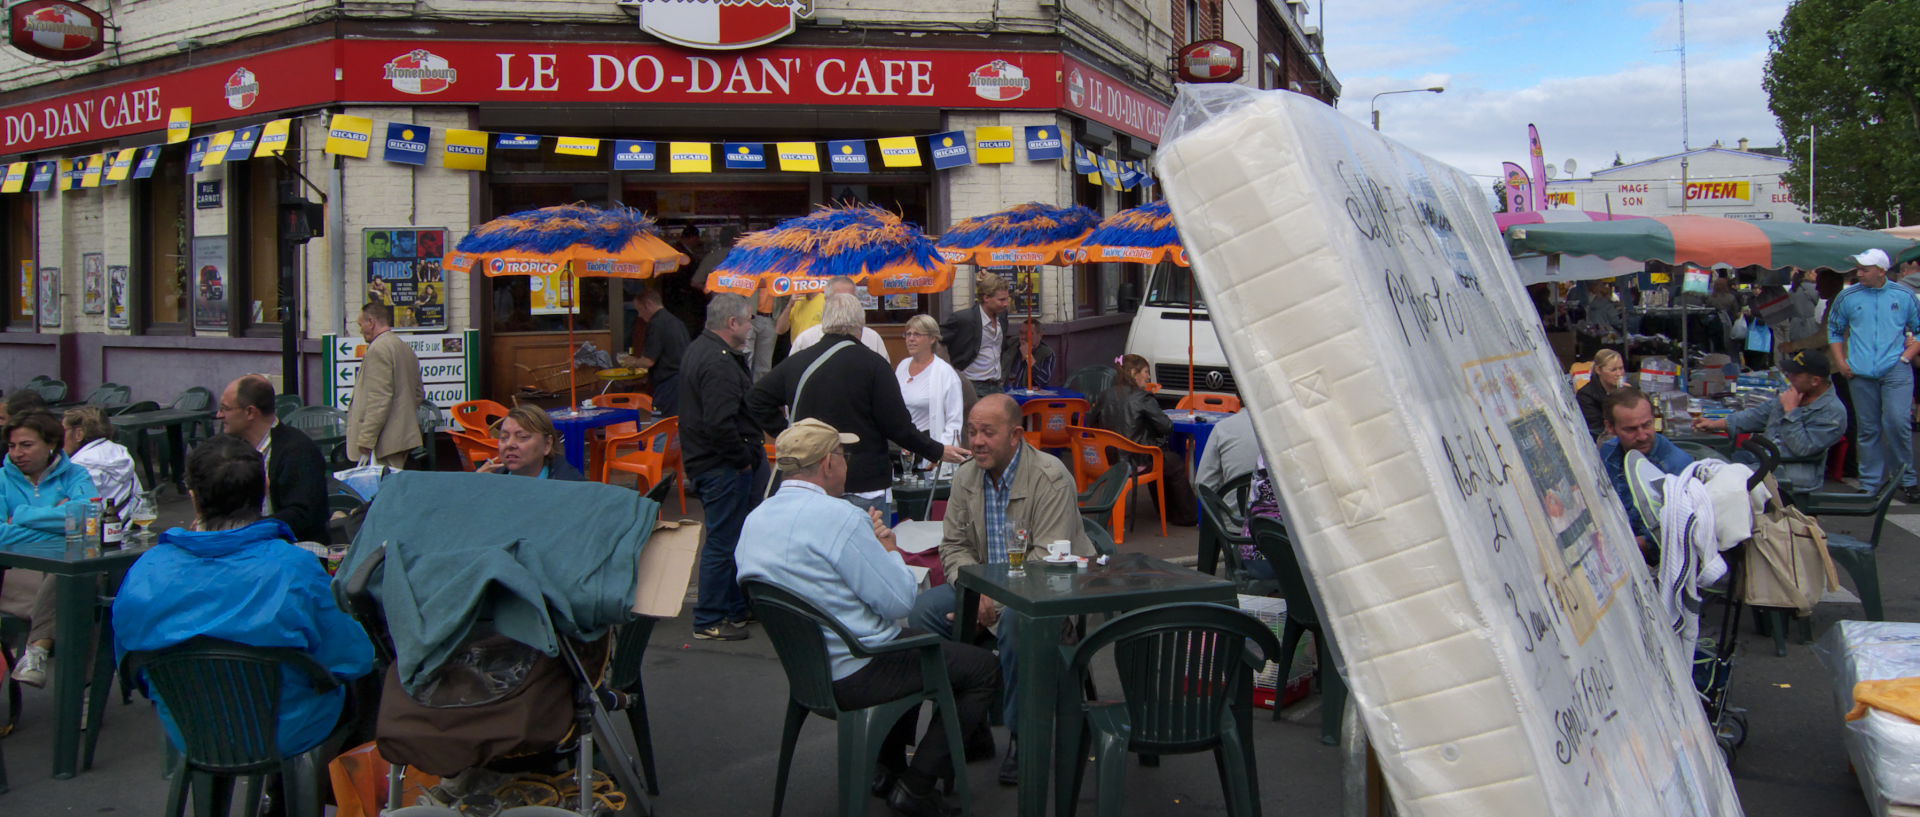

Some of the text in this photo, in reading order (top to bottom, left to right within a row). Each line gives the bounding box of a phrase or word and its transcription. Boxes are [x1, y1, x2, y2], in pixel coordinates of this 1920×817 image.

[384, 63, 456, 83] Kronenbourg
[496, 53, 935, 96] LE DO-DAN' CAFE
[968, 72, 1030, 92] Kronenbourg
[1089, 77, 1103, 113] LE
[5, 87, 161, 146] DO-DAN' CAFE
[331, 130, 368, 142] RICARD
[388, 140, 426, 153] RICARD
[447, 144, 485, 155] RICARD
[978, 140, 1011, 149] RICARD
[1028, 139, 1060, 149] RICARD
[934, 146, 966, 158] RICARD
[832, 154, 866, 163] RICARD
[203, 184, 214, 193] RUE
[1618, 183, 1649, 193] IMAGE
[1686, 183, 1737, 200] GITEM
[198, 194, 220, 203] CARNOT
[1622, 197, 1643, 206] SON
[1771, 193, 1793, 203] ELEC
[507, 263, 558, 274] TROPICO
[793, 280, 828, 292] TROP
[420, 364, 463, 377] ISOPTIC
[427, 390, 463, 401] ACLOU
